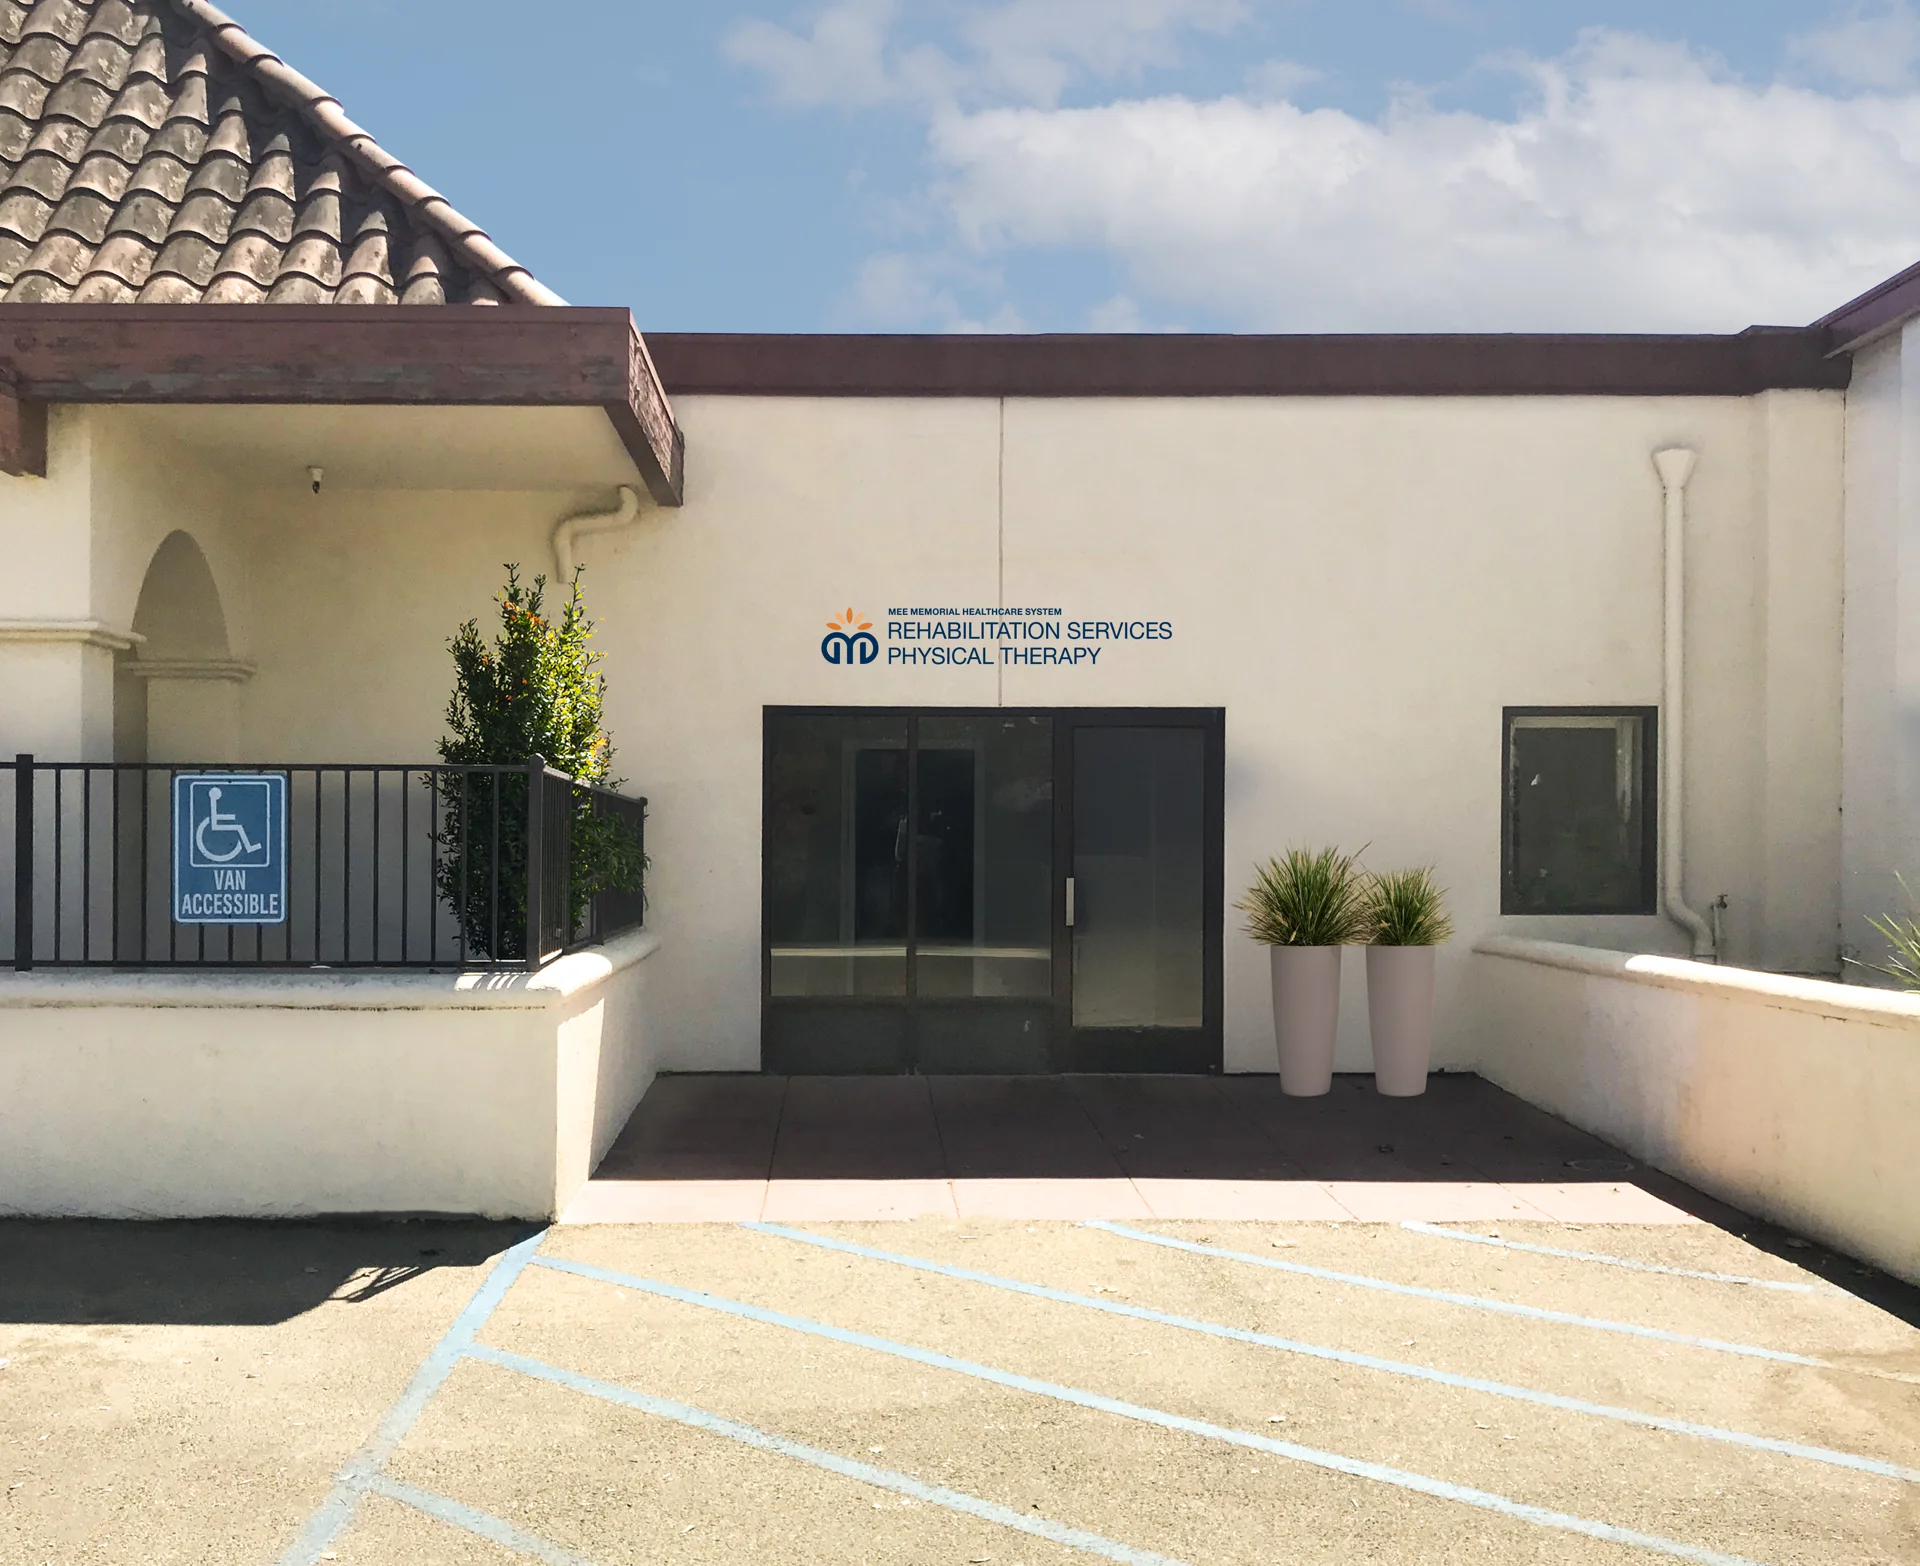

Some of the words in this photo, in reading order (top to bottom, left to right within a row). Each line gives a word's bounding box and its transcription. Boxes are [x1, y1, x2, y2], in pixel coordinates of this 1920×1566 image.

[888, 608, 908, 616] MEE
[910, 608, 960, 616] MEMORIAL
[962, 608, 1023, 616] HEALTHCARE
[1025, 608, 1062, 616] SYSTEM
[888, 621, 1060, 640] REHABILITATION
[1067, 621, 1173, 640] SERVICES
[888, 647, 994, 665] PHYSICAL
[1000, 647, 1102, 665] THERAPY
[214, 869, 246, 890] VAN
[182, 893, 278, 914] ACCESSIBLE
